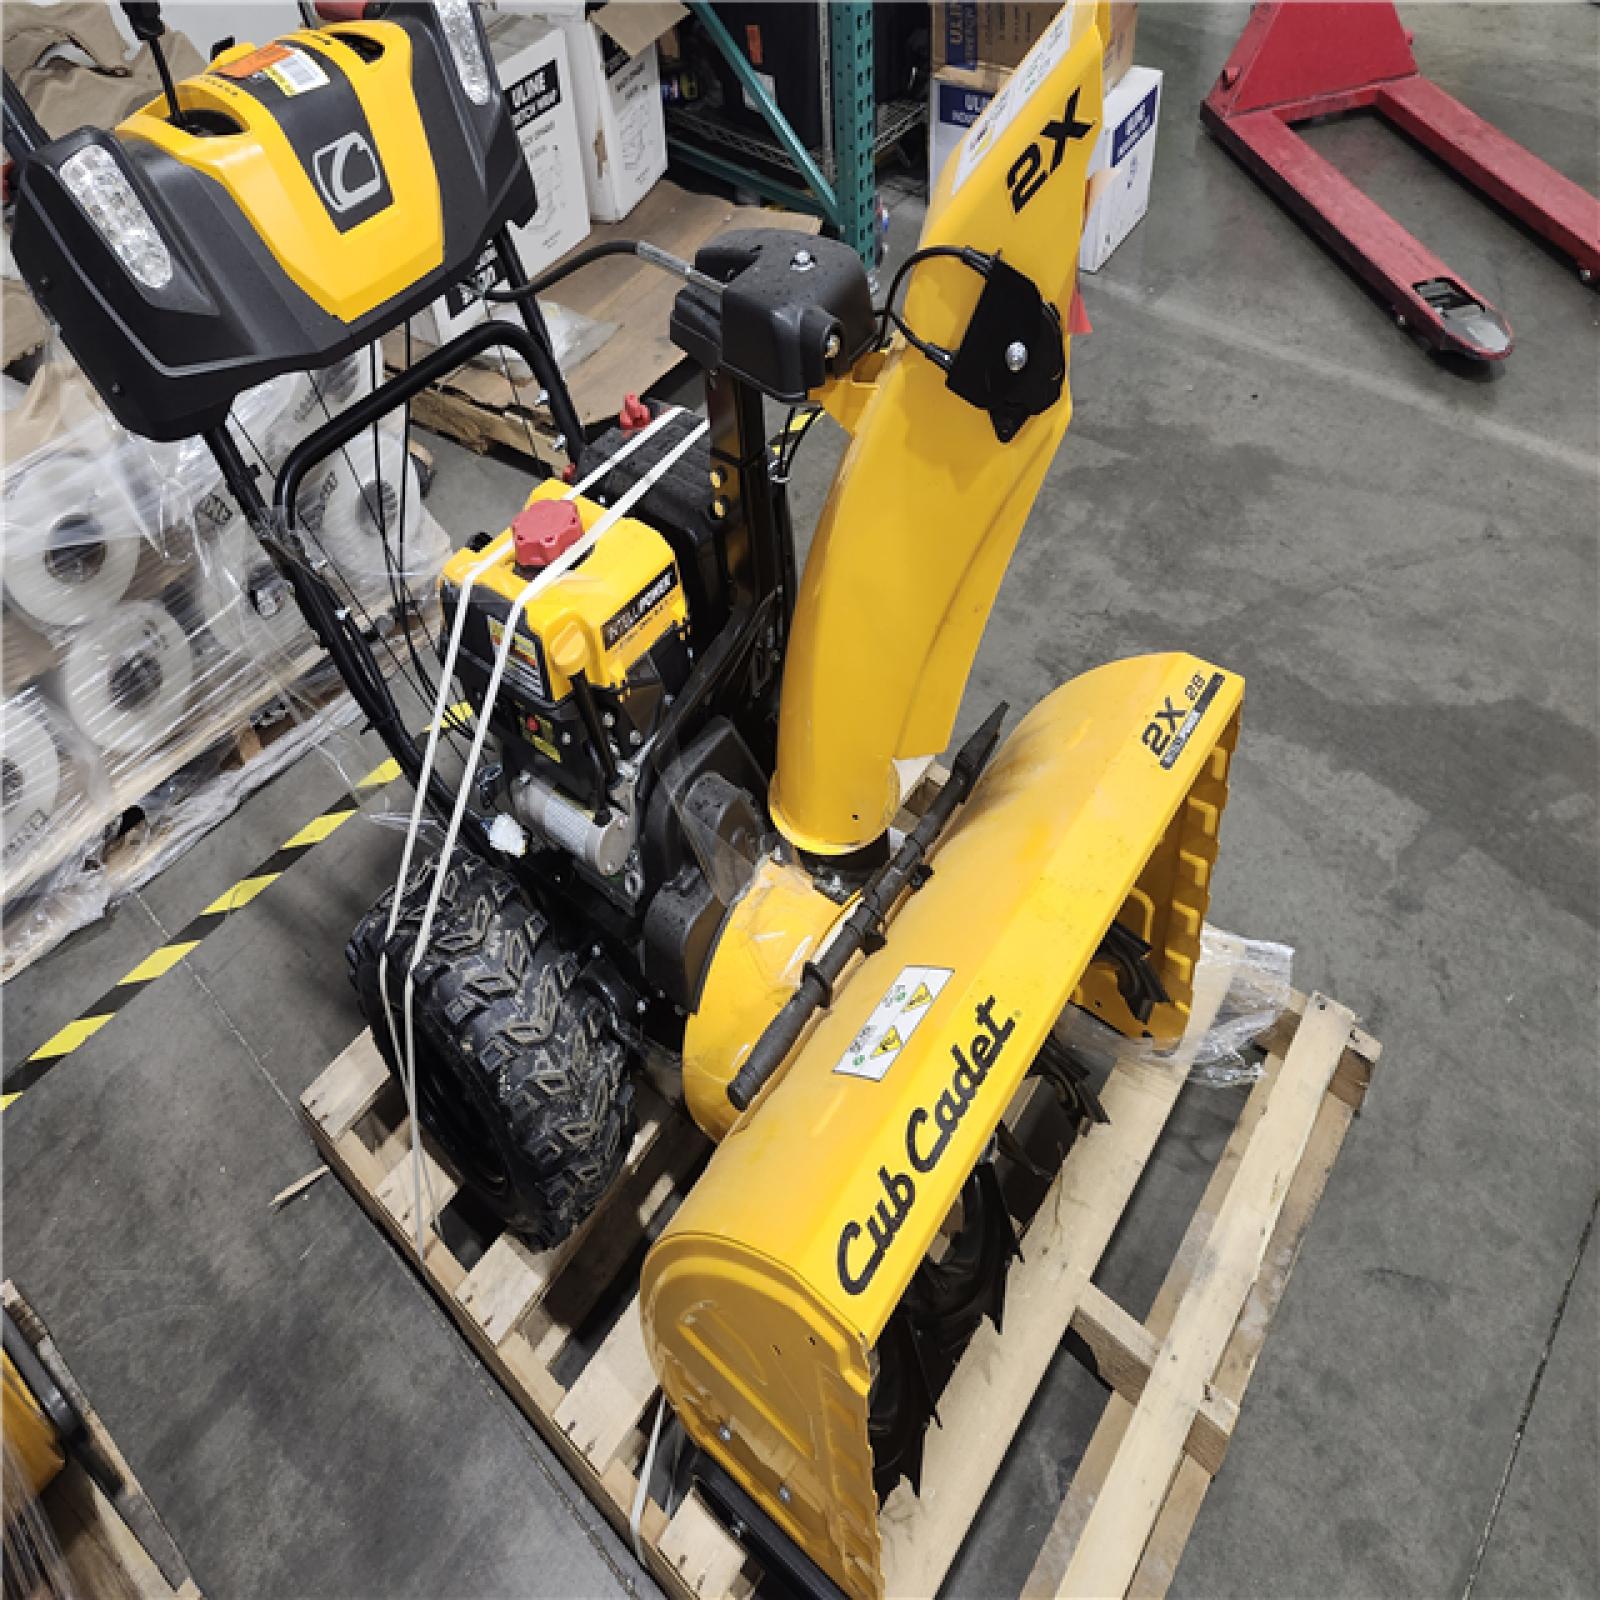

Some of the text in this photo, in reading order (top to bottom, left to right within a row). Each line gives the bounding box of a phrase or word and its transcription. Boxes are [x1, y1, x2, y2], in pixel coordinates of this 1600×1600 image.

[1006, 87, 1094, 214] 2X
[1141, 694, 1186, 756] 2X
[837, 1164, 915, 1296] Cub
[905, 995, 1016, 1173] Cadet
